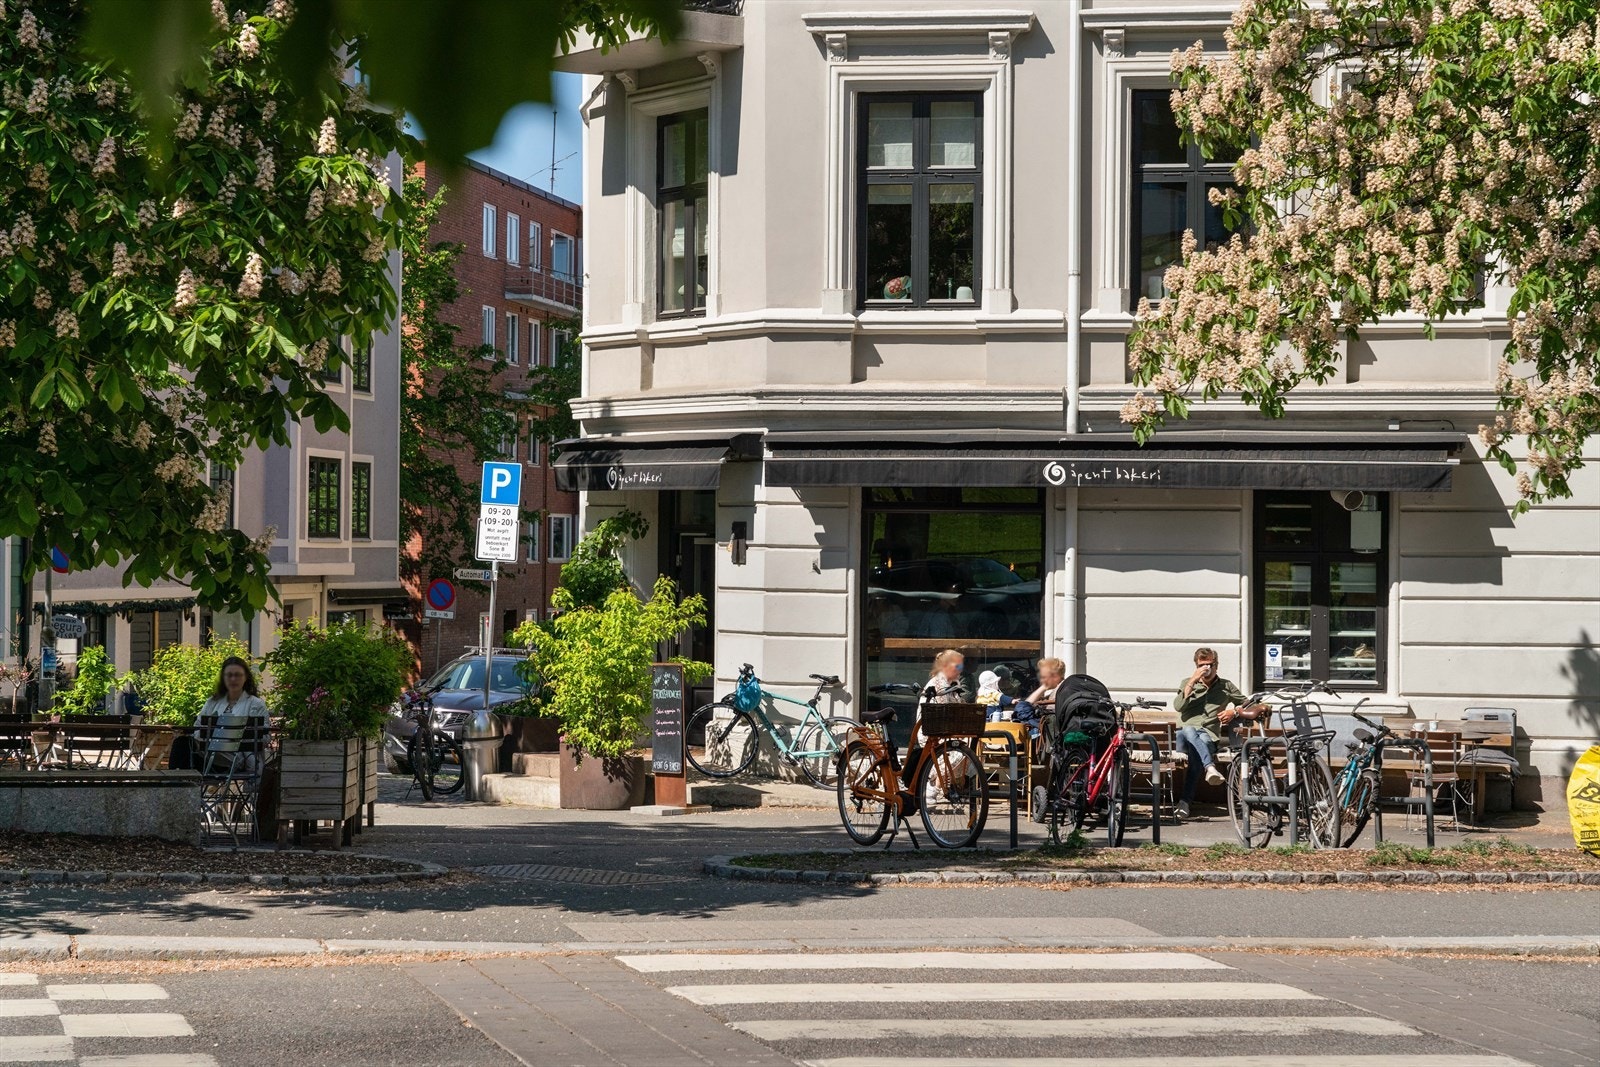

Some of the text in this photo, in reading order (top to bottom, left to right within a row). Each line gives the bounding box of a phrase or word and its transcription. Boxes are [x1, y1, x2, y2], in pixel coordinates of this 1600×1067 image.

[639, 471, 663, 485] bakeri
[1116, 466, 1161, 482] bakeri
[491, 468, 512, 499] P
[460, 570, 484, 578] Automat
